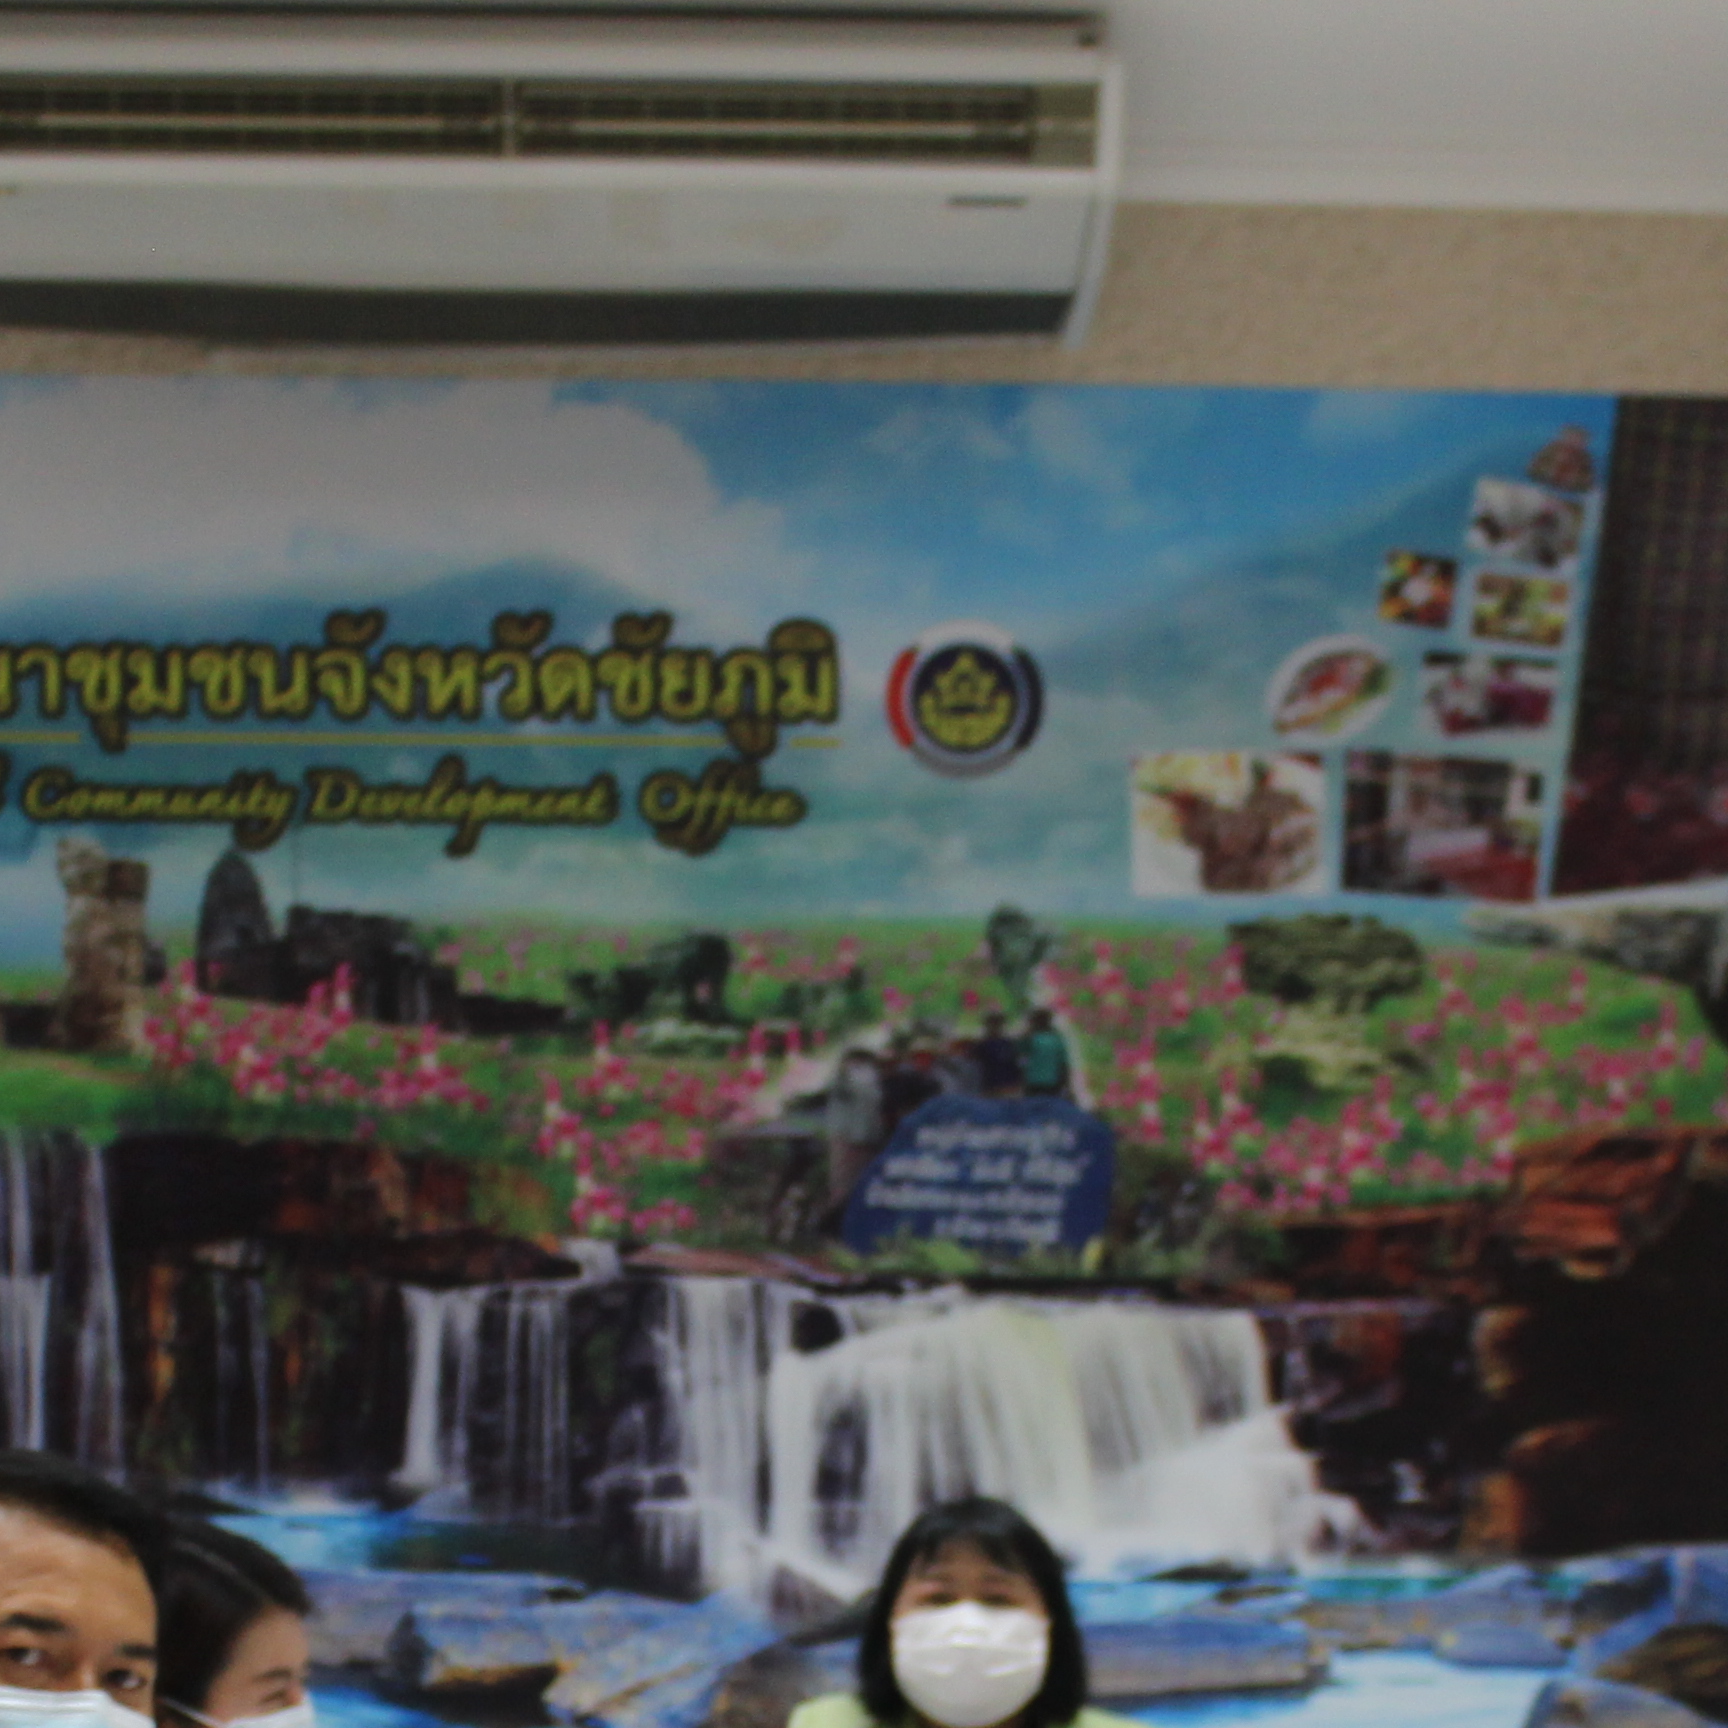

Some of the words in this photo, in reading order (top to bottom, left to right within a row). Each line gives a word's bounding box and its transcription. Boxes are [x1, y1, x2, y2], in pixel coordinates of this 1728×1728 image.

[22, 766, 298, 851] Community
[303, 754, 619, 857] Development
[639, 757, 807, 856] Office
